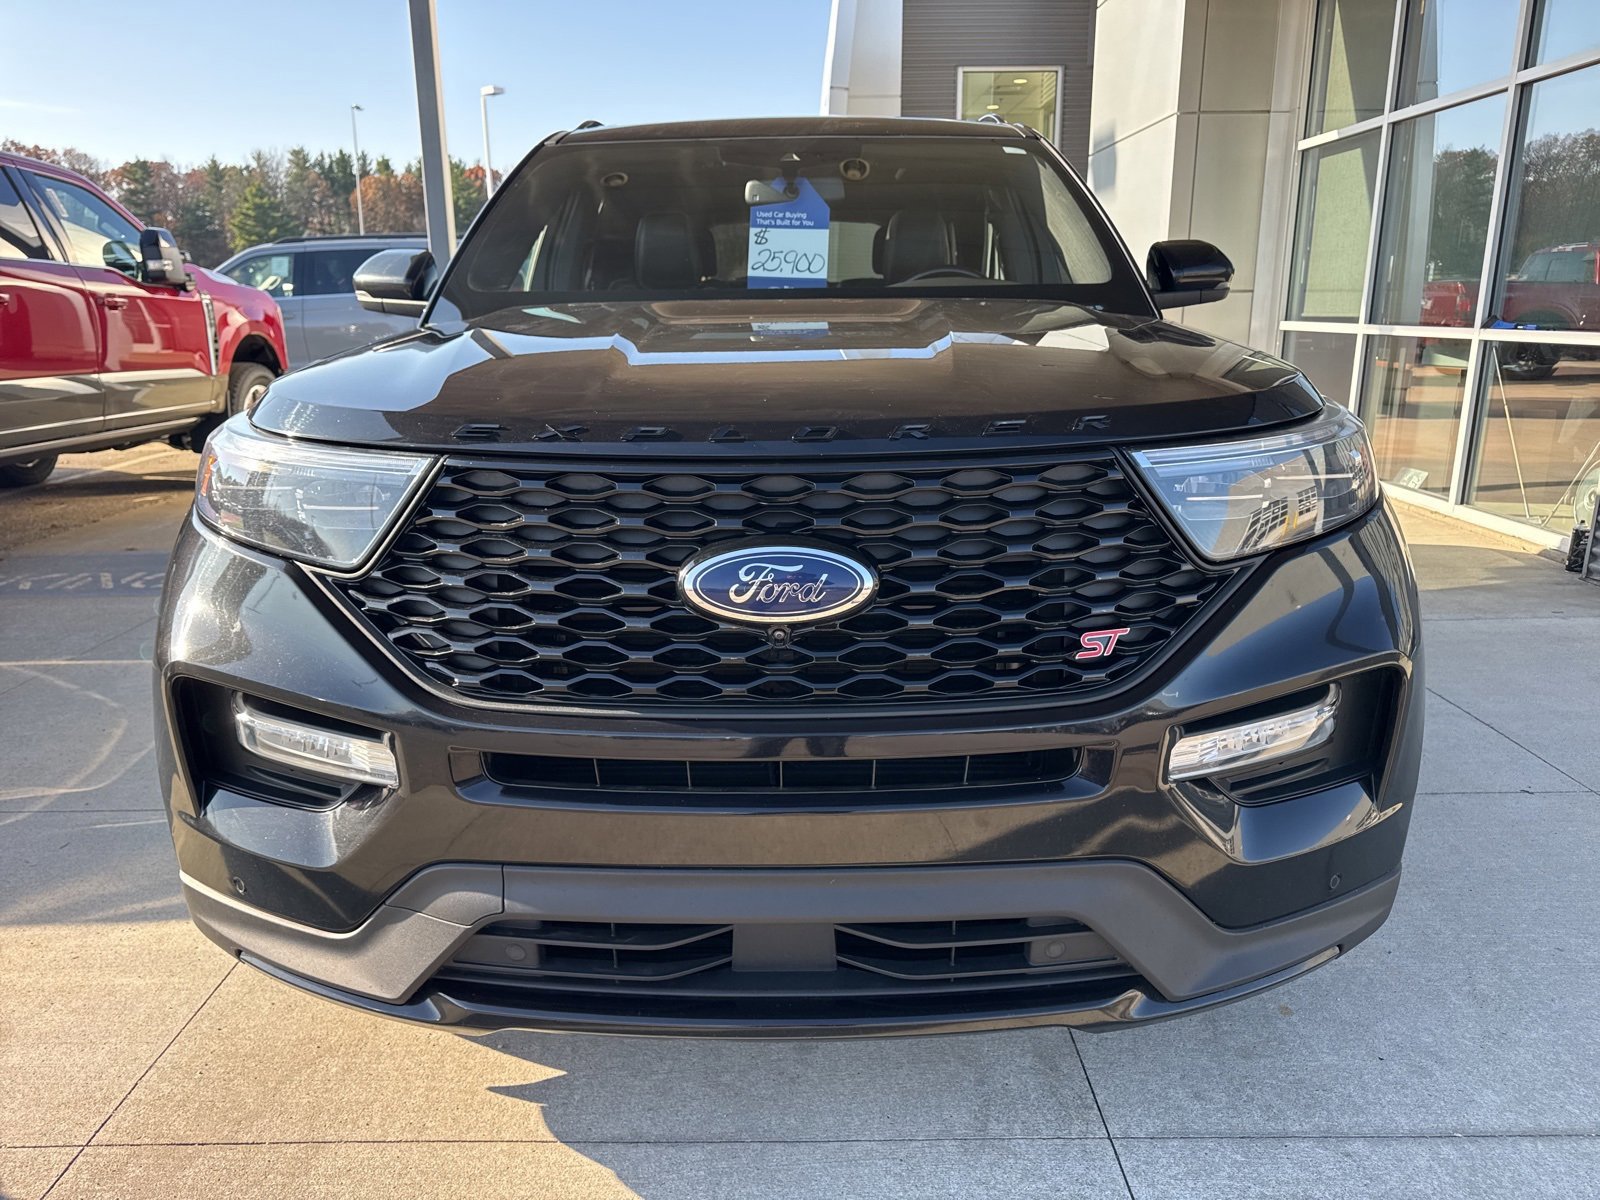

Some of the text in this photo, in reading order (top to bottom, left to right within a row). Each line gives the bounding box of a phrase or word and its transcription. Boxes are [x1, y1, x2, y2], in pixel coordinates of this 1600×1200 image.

[785, 212, 807, 220] Buying
[754, 227, 770, 245] $
[452, 414, 1112, 443] EXPLORER
[728, 563, 829, 604] Ford
[1075, 627, 1131, 660] ST
